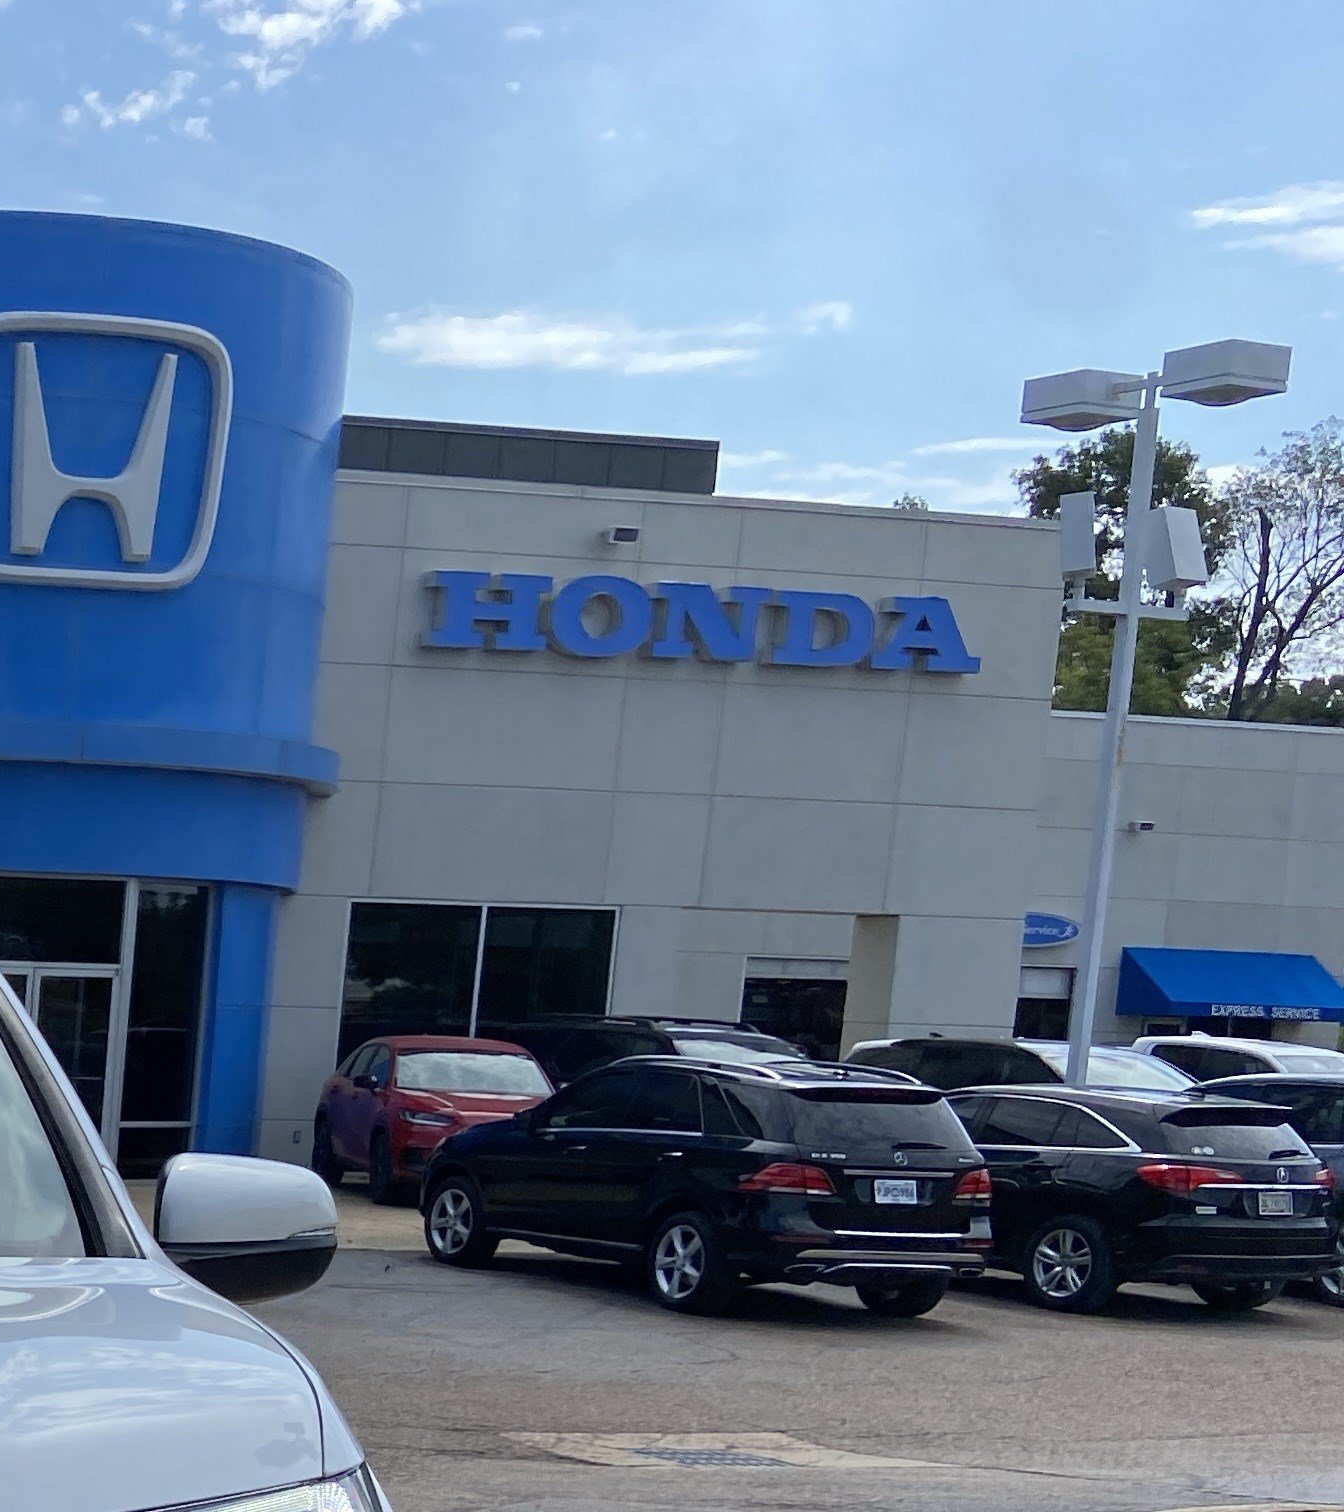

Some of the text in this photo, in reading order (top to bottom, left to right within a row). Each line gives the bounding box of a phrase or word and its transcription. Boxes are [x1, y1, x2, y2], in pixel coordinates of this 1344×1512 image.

[422, 570, 980, 673] HONDA
[1211, 1004, 1321, 1020] EXPRESS SERVICE
